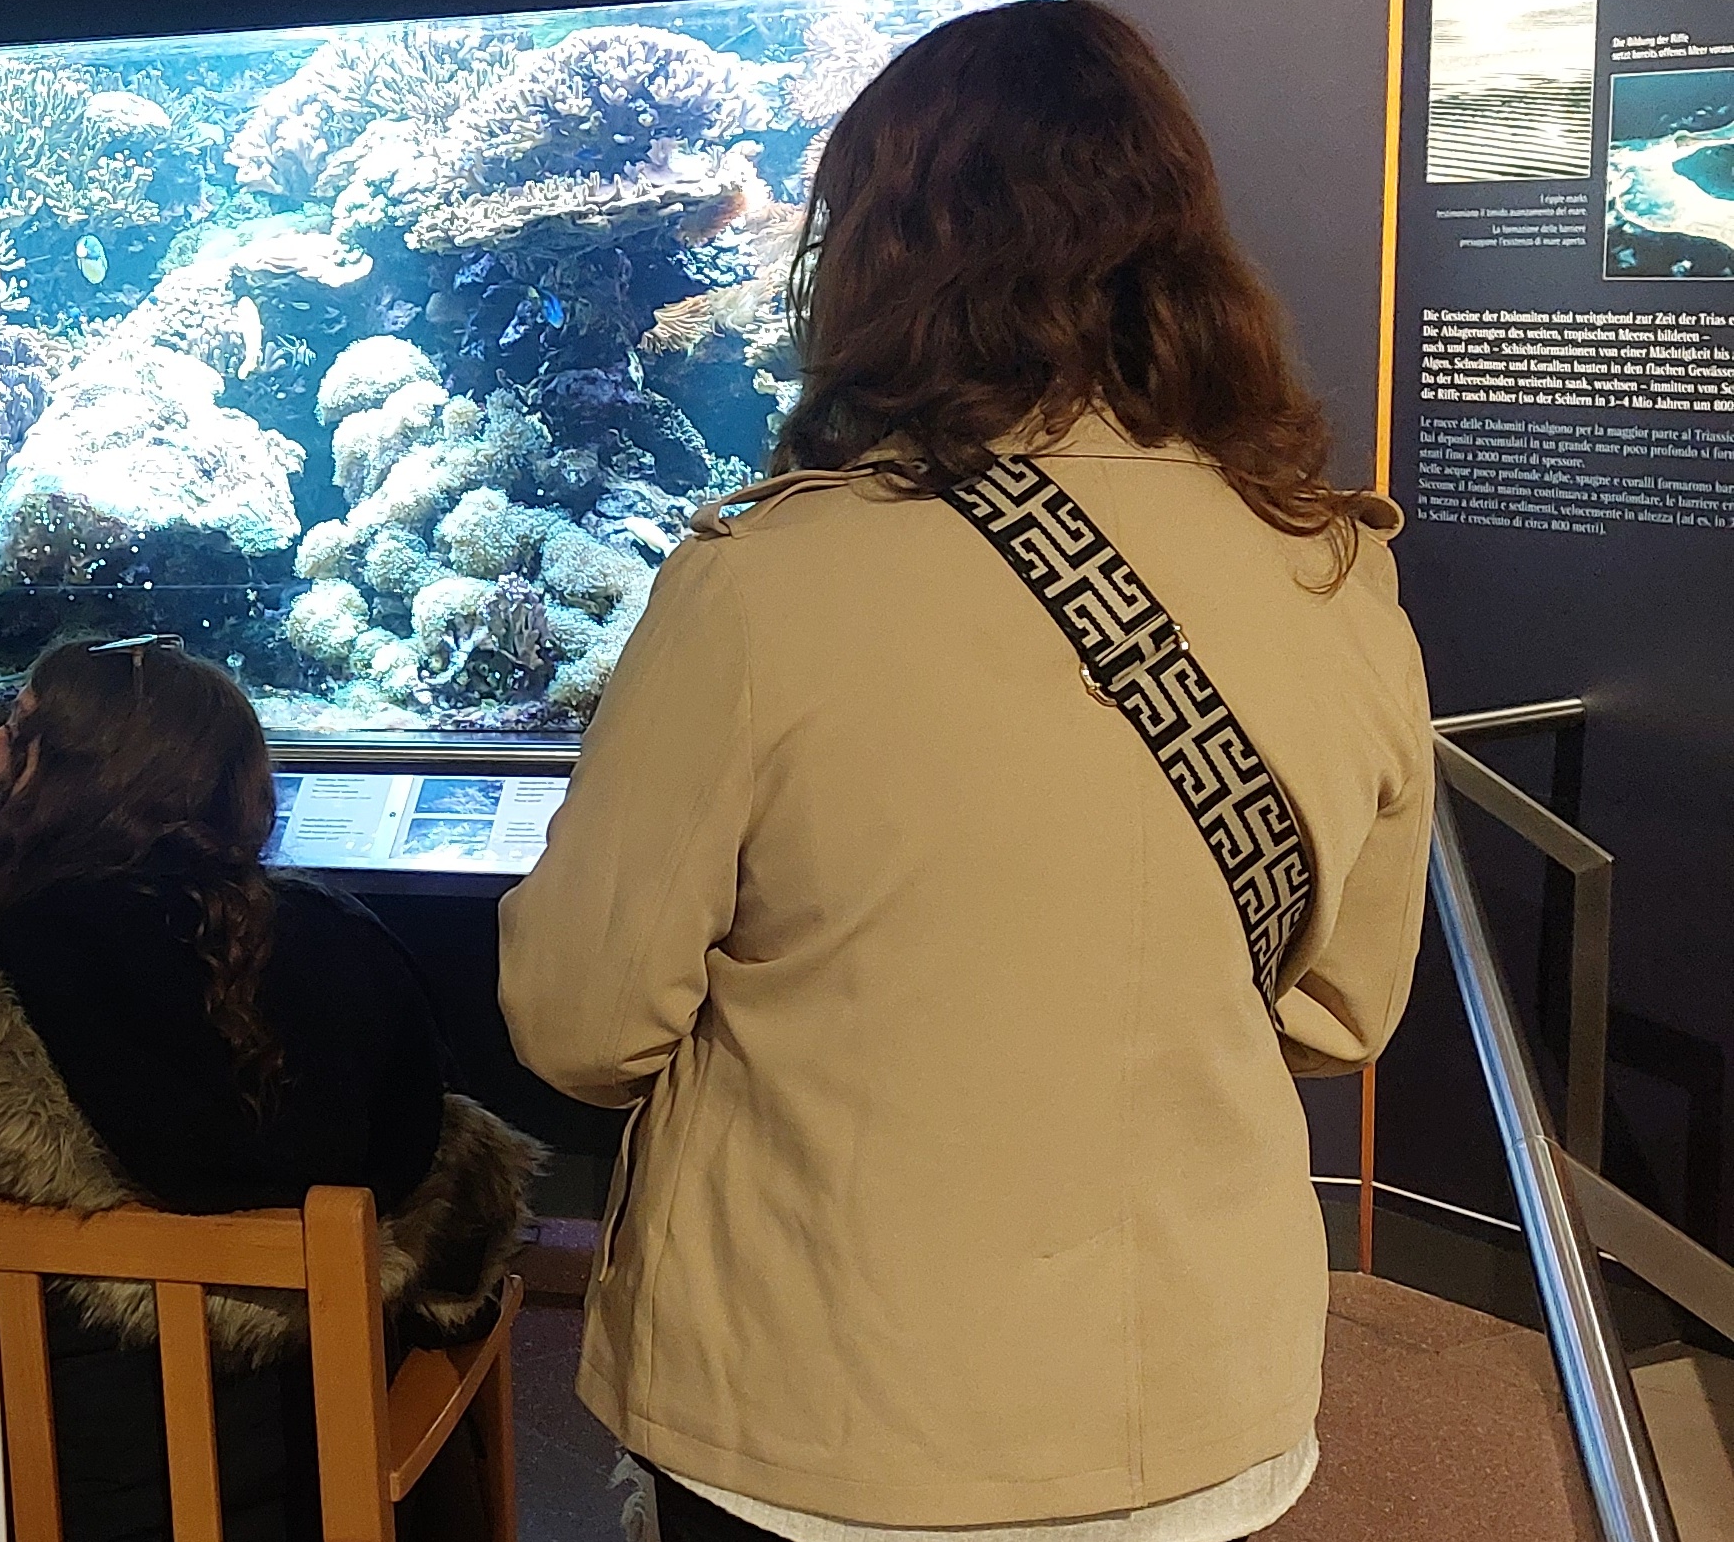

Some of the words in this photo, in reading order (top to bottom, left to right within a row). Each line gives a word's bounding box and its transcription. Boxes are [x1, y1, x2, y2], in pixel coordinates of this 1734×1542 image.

[1423, 309, 1439, 322] Die
[1482, 309, 1498, 323] der
[1500, 310, 1550, 324] Dolomiten
[1551, 310, 1574, 324] sind
[1576, 310, 1633, 327] weitgehend
[1635, 313, 1653, 325] zur
[1678, 312, 1697, 326] der
[1699, 312, 1726, 327] Trias
[1422, 325, 1439, 338] Die
[1440, 326, 1506, 341] Ablagerungen
[1564, 327, 1616, 343] tropischen
[1422, 340, 1445, 353] nach
[1447, 341, 1465, 354] und
[1467, 342, 1491, 355] nach
[1508, 359, 1528, 372] und
[1529, 359, 1572, 373] Korallen
[1623, 361, 1644, 375] den
[1687, 363, 1734, 378] Gewässe
[1421, 372, 1435, 385] Da
[1436, 372, 1452, 385] der
[1420, 387, 1436, 401] die
